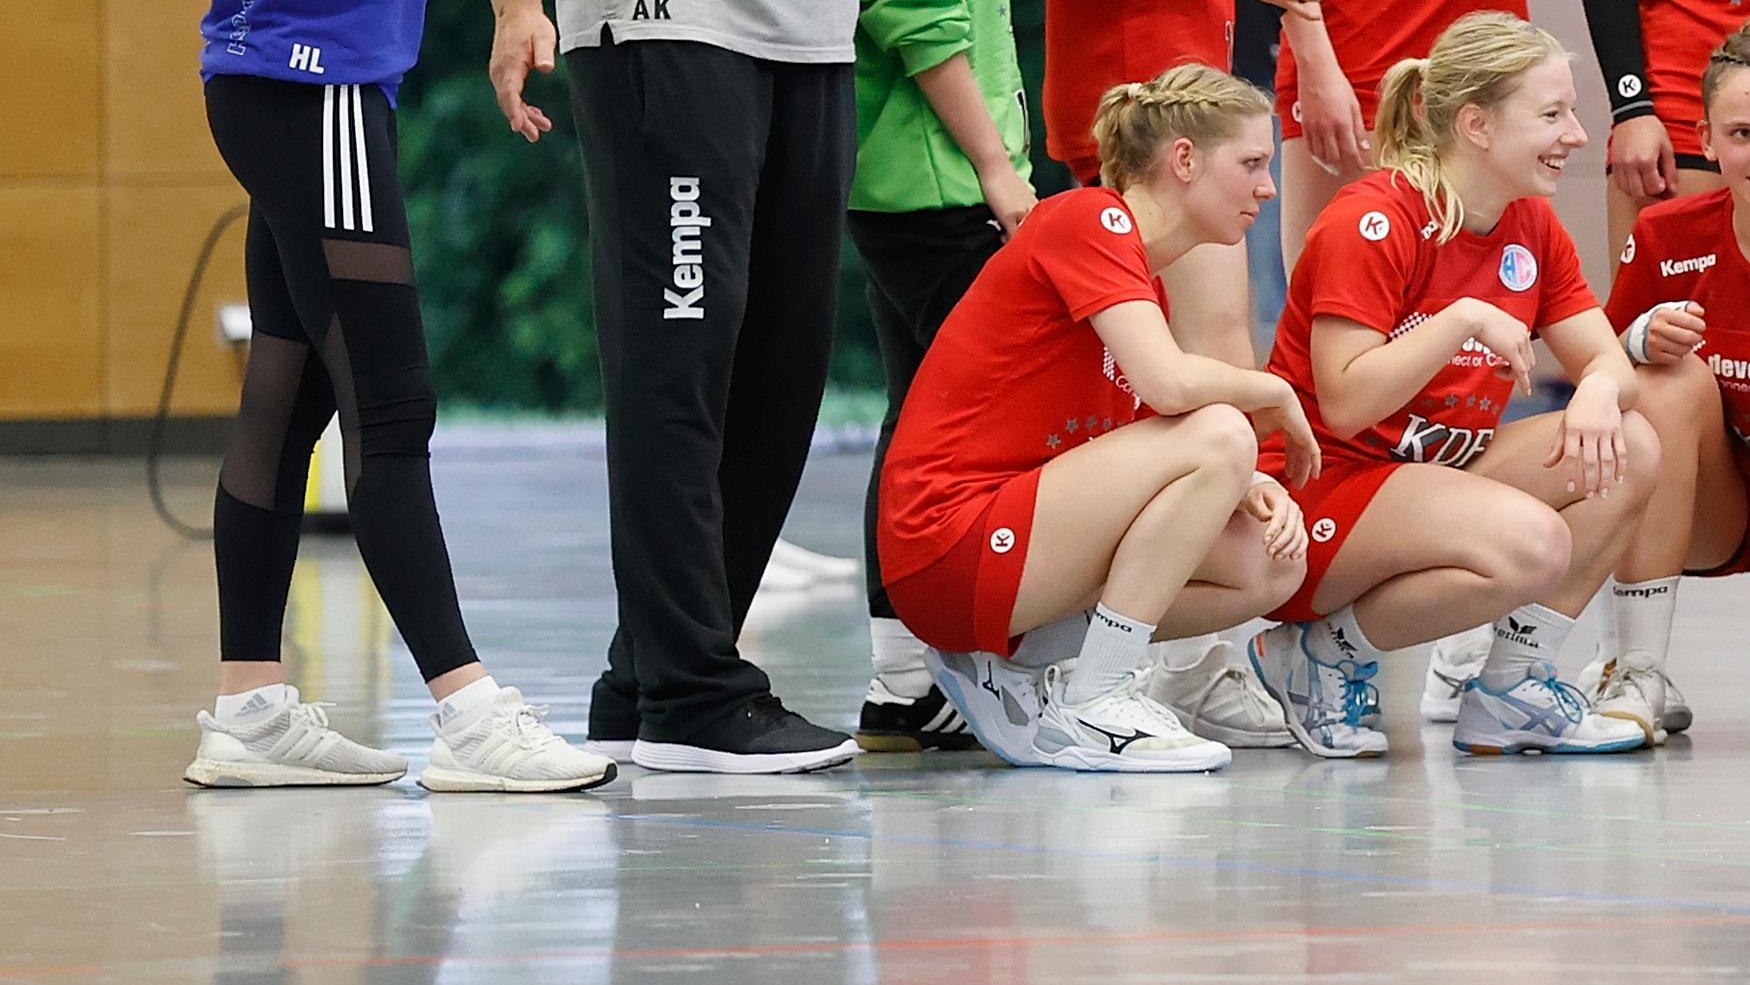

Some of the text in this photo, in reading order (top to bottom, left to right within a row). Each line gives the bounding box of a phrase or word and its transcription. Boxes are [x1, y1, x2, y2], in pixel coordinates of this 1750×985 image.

[289, 43, 325, 74] HL
[664, 177, 712, 319] Kempa
[1660, 254, 1716, 277] Kempa
[1096, 612, 1132, 633] mpa
